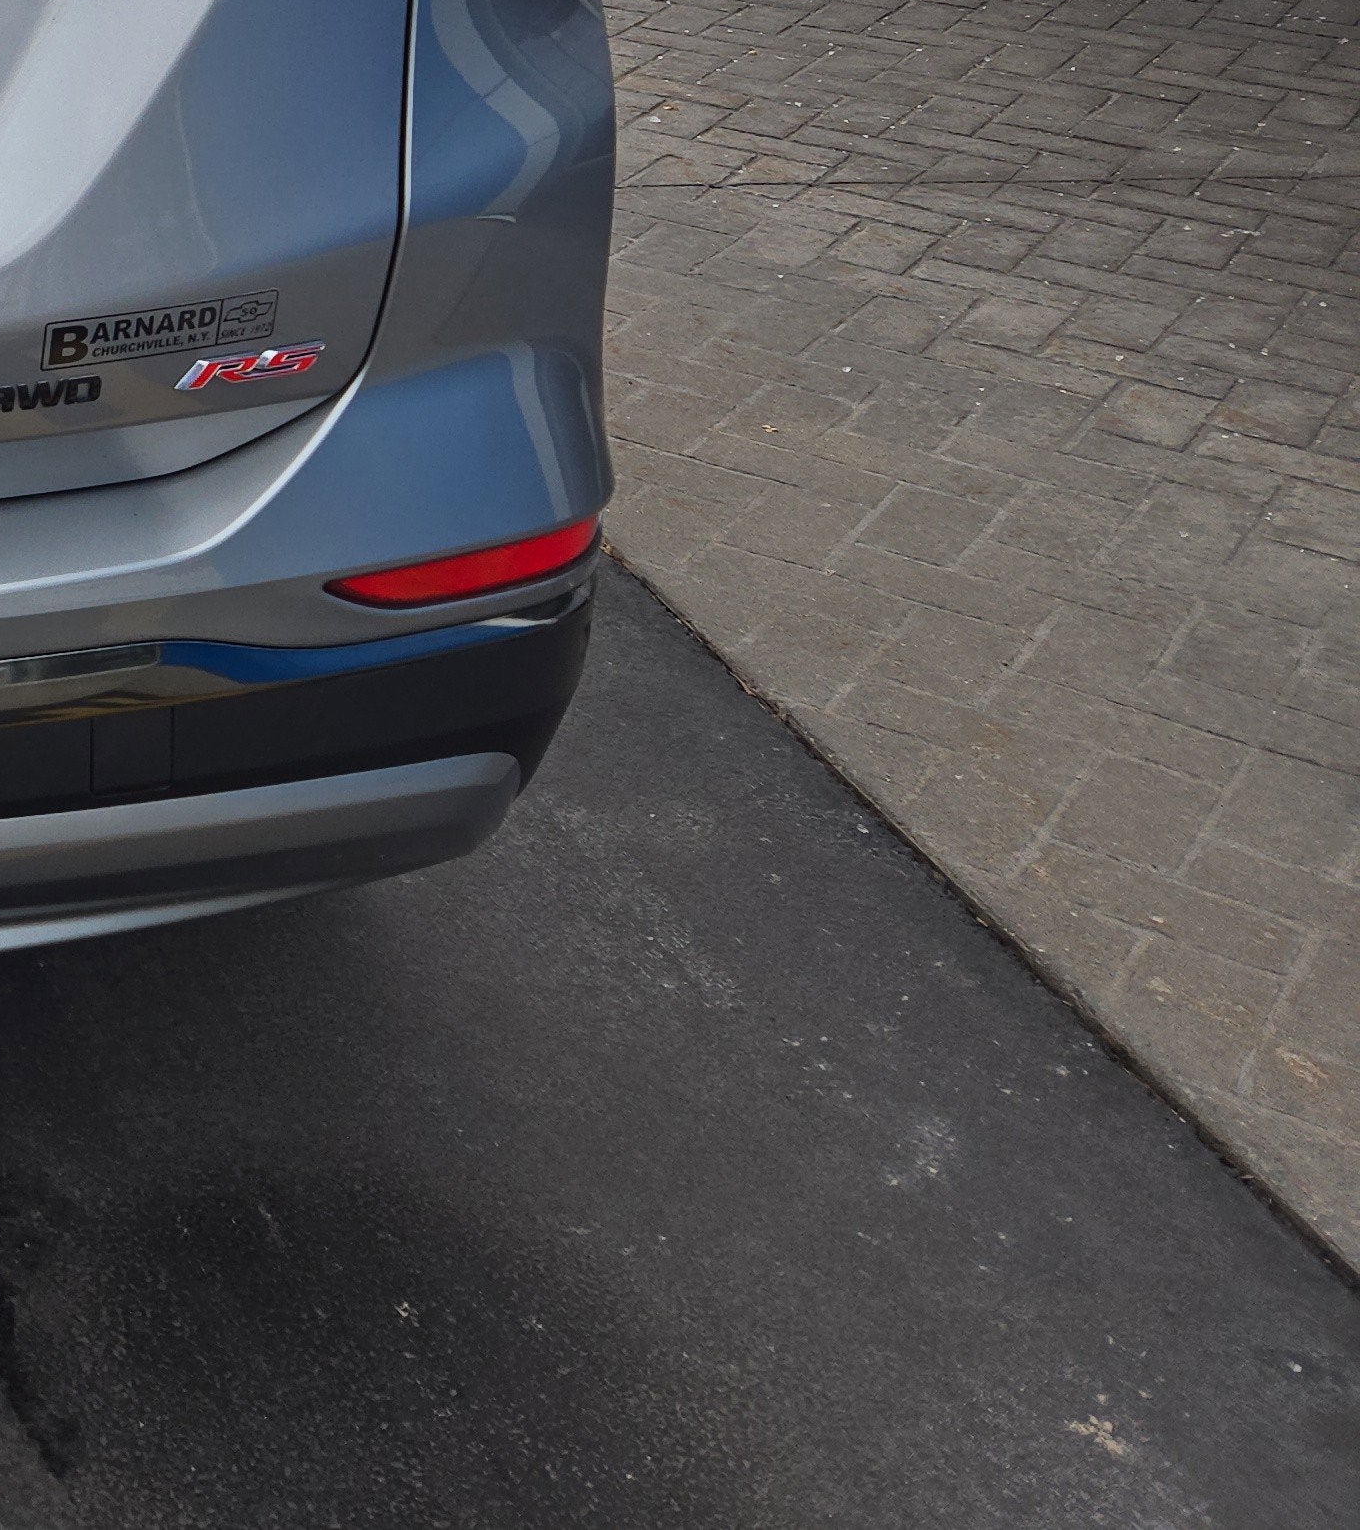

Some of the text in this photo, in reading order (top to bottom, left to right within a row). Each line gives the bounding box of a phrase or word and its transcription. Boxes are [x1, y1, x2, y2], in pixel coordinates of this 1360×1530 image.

[48, 306, 217, 366] BARNARD
[92, 330, 211, 358] CHURCHVILLE, N.Y.
[174, 341, 326, 391] RS
